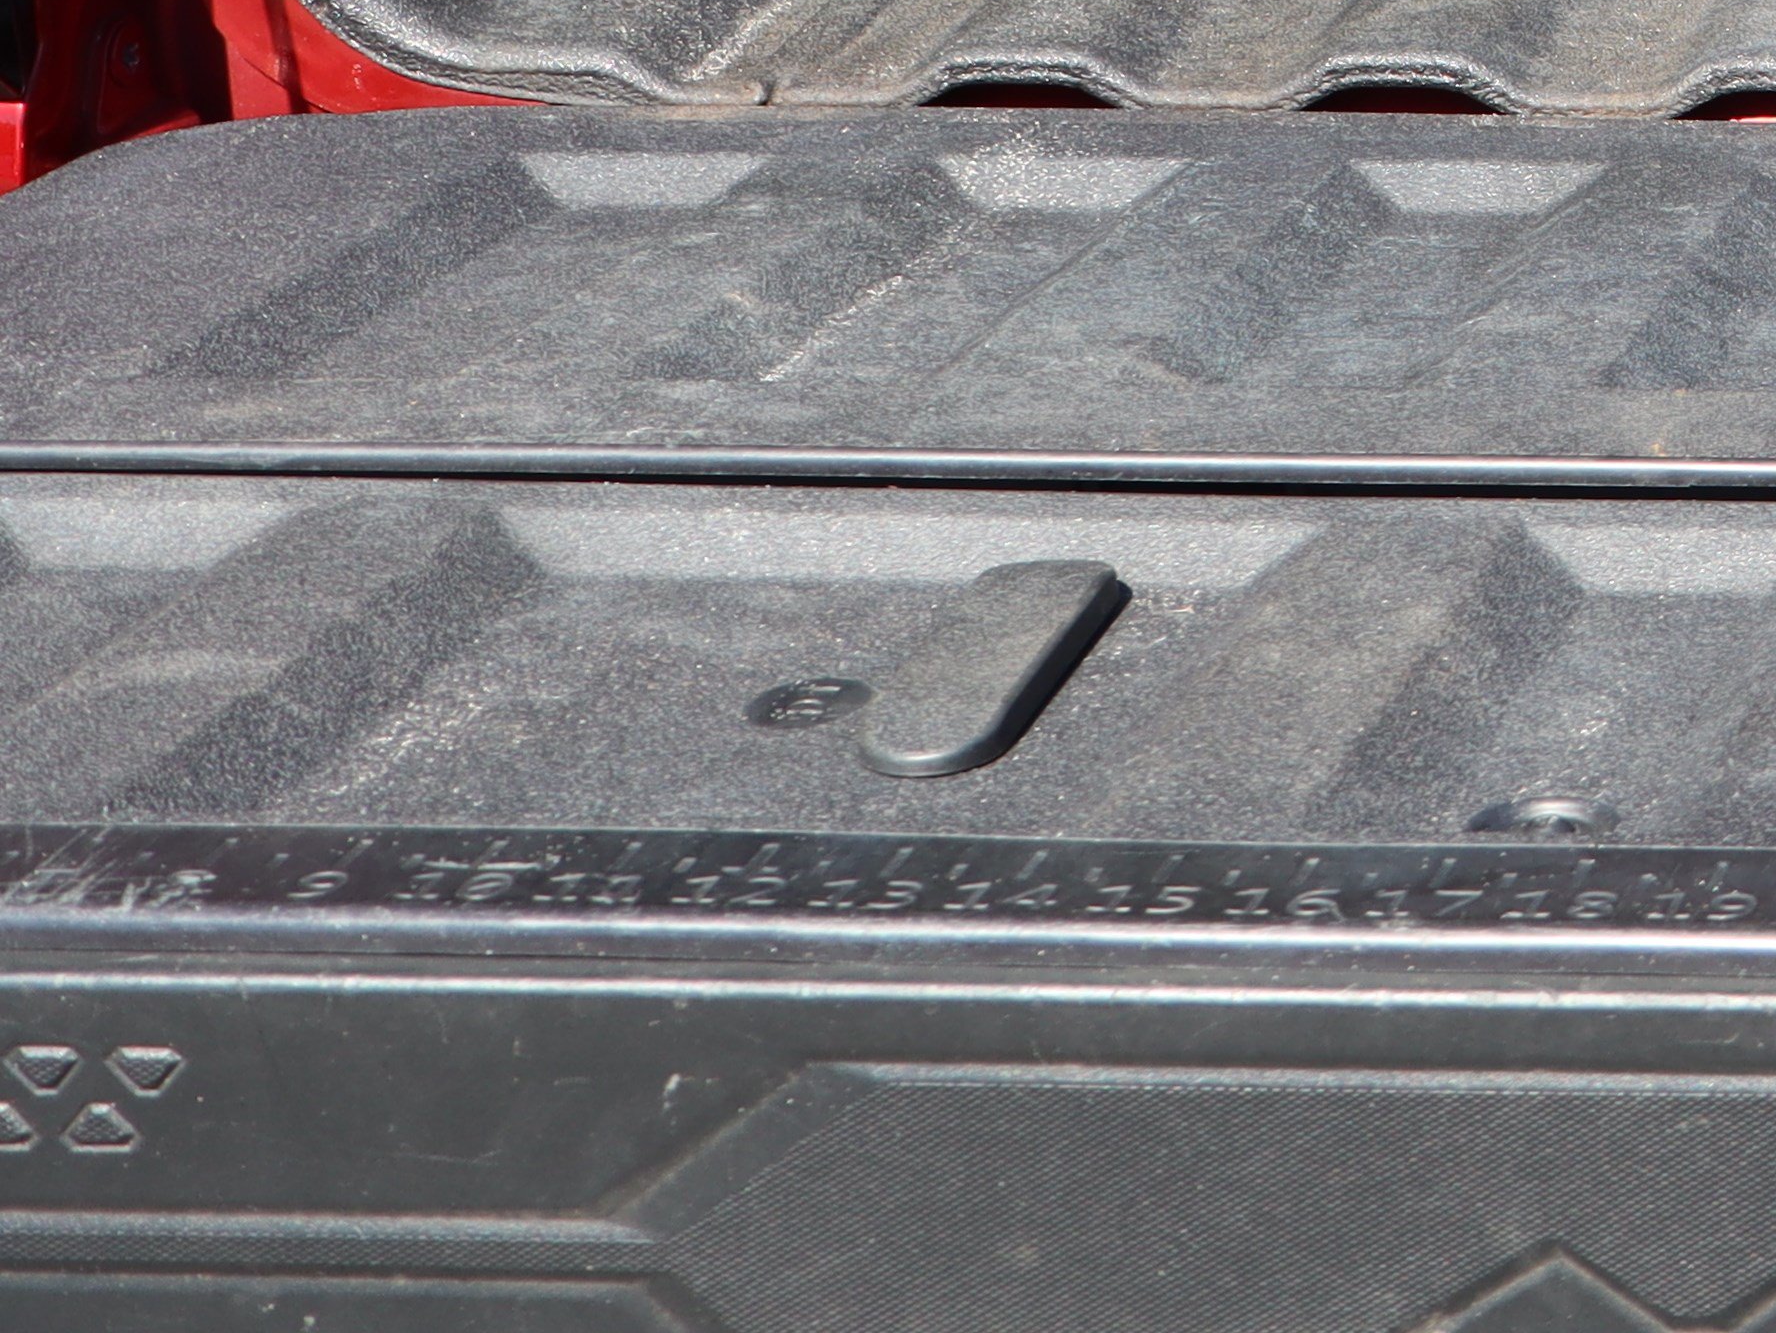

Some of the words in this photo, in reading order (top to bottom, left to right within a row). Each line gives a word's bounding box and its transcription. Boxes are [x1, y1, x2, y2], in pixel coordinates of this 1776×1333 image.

[287, 870, 349, 900] 9
[394, 872, 515, 902] 10
[531, 873, 642, 904] 11
[671, 876, 788, 906] 12
[807, 879, 924, 910] 13
[944, 882, 1059, 911] 14
[1086, 885, 1201, 915] 15
[1224, 888, 1342, 917] 16
[1364, 889, 1484, 918] 17
[1500, 890, 1618, 919] 18
[1646, 892, 1758, 921] 19
